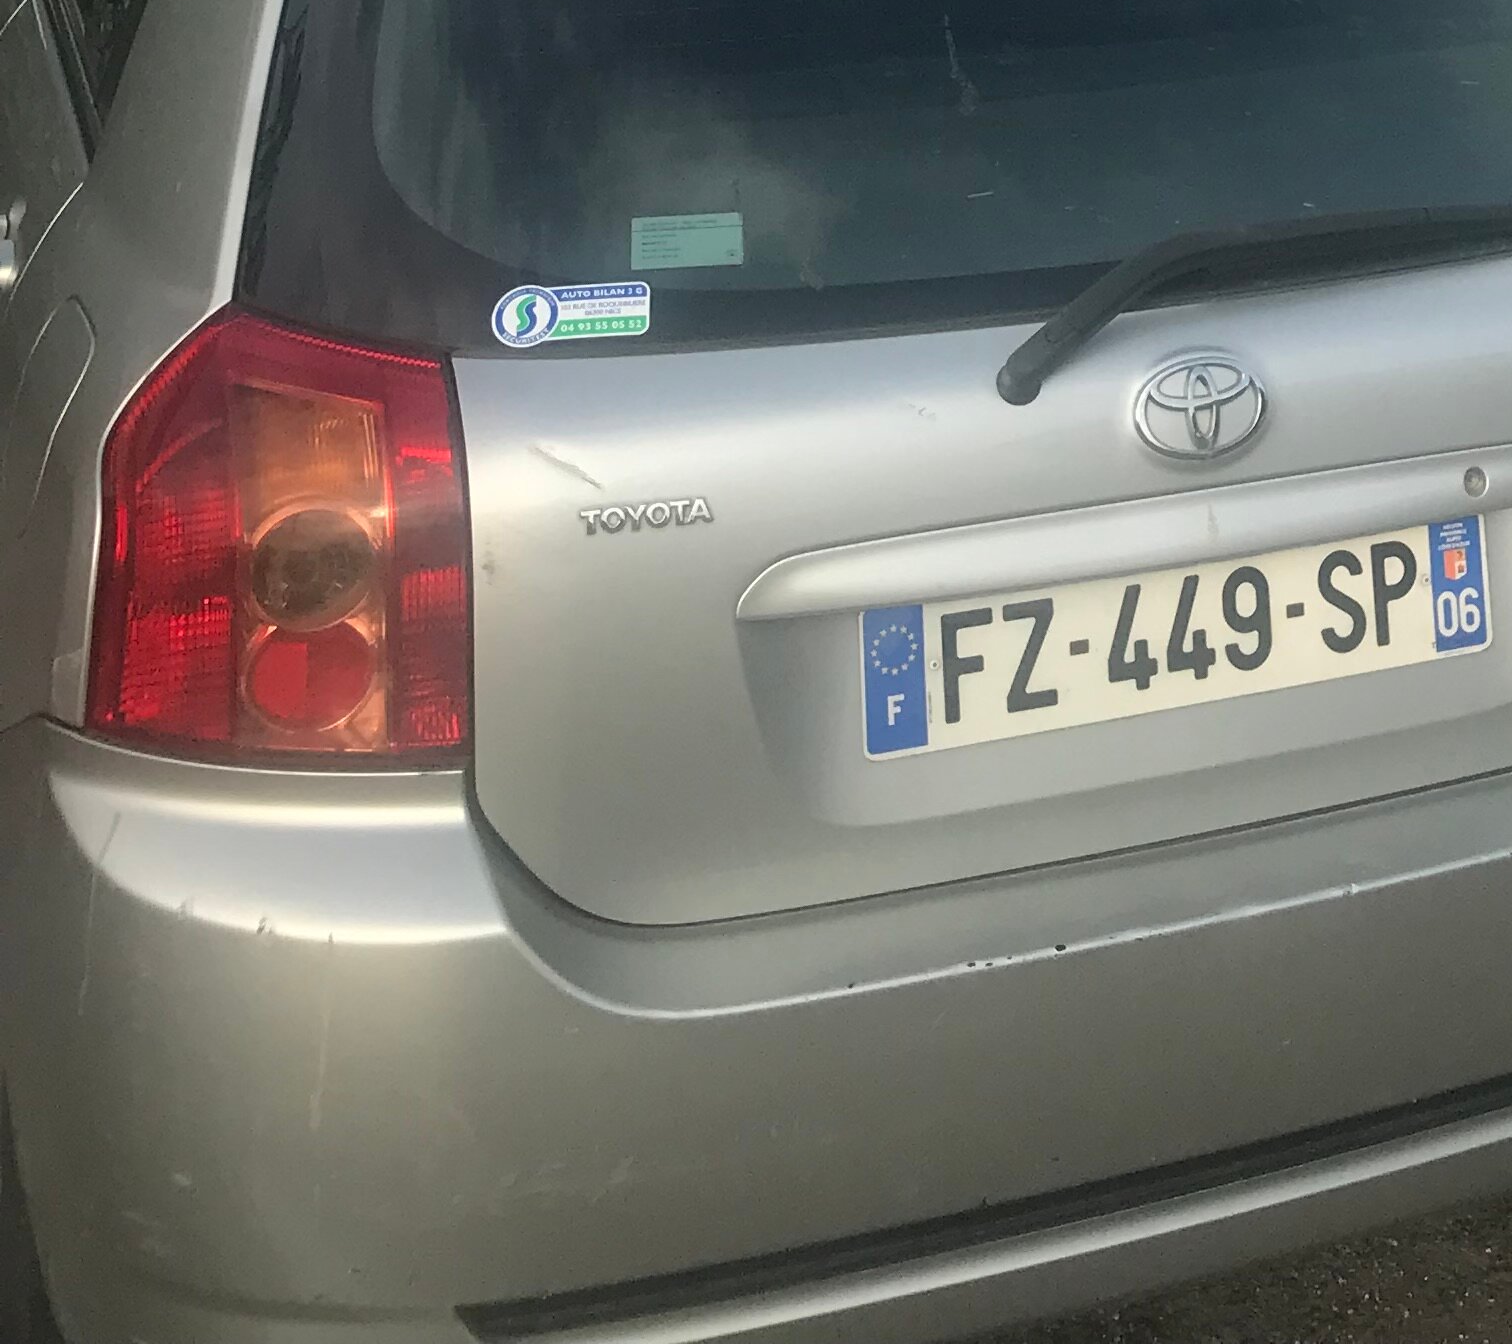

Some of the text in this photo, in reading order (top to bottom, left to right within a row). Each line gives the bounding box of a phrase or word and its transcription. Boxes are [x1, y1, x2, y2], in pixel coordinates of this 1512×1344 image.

[561, 290, 591, 299] AUTO
[594, 288, 625, 297] BILAN
[636, 287, 643, 295] G
[560, 319, 642, 332] 04 93 55 05 52
[580, 497, 714, 535] TOYOTA
[887, 694, 905, 726] F
[941, 540, 1417, 724] FZ-449-SP
[1437, 587, 1481, 637] 06
